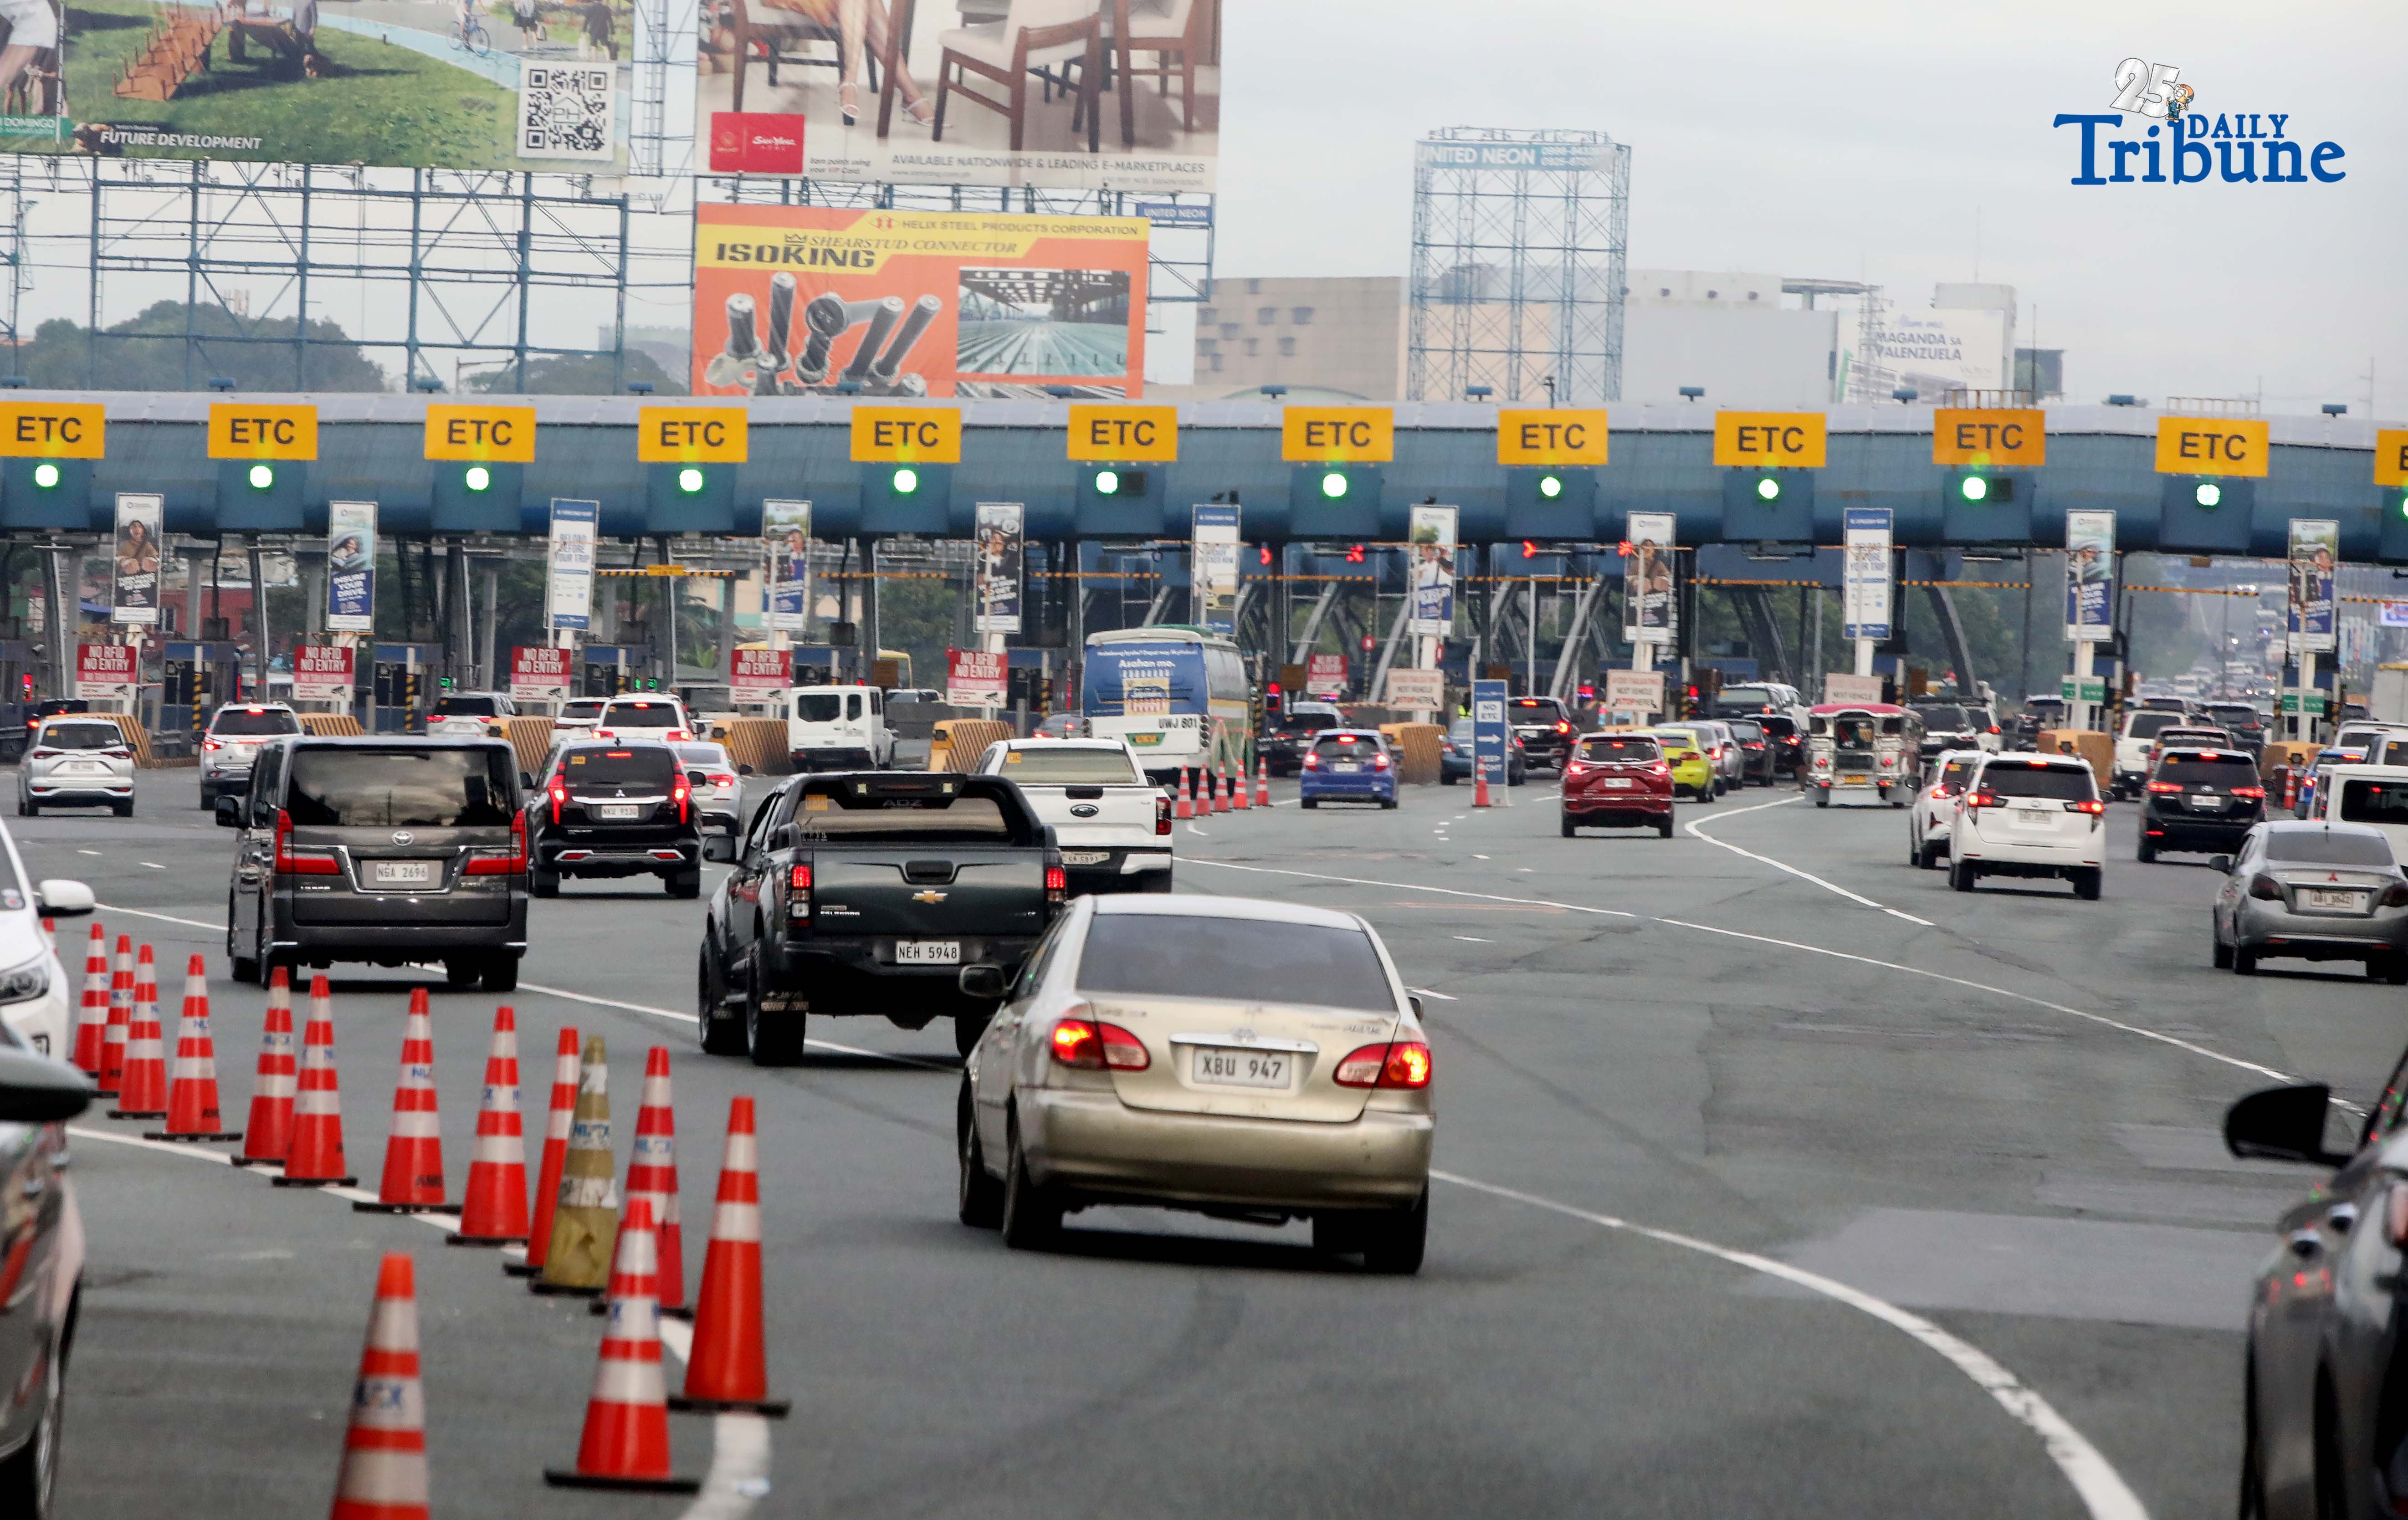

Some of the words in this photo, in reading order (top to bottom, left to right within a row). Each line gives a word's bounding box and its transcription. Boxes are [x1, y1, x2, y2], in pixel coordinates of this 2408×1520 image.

[100, 131, 156, 145] FUTURE
[157, 133, 262, 150] DEVELOPMENT
[891, 154, 954, 166] AVAILABLE
[957, 157, 1033, 169] NATIONWIDE
[1037, 159, 1044, 169] &
[1048, 159, 1098, 170] LEADING
[1102, 160, 1206, 173] E-MARKETPLACES
[1417, 144, 1477, 164] UNITED
[1482, 148, 1535, 165] NEON
[1177, 209, 1208, 219] NEON
[902, 220, 937, 230] HELIX
[940, 221, 977, 230] STEEL
[983, 222, 1049, 233] PRODUCTS
[1051, 224, 1138, 235] CORPORATION
[810, 235, 908, 250] SHEARSTUD
[913, 239, 1018, 253] CONNECTOR
[717, 242, 876, 268] ISOKING
[1877, 332, 1946, 345] MAGANDA
[17, 416, 81, 442] ETC
[231, 418, 294, 444] ETC
[448, 420, 512, 445] ETC
[661, 421, 724, 447] ETC
[875, 421, 938, 447] ETC
[1091, 420, 1155, 446] ETC
[1306, 421, 1370, 447] ETC
[1522, 424, 1585, 449] ETC
[1957, 424, 2023, 450] ETC
[1738, 426, 1803, 453] ETC
[2180, 432, 2246, 461] ETC
[89, 645, 102, 658] NO
[103, 646, 126, 659] RFID
[306, 646, 319, 659] NO
[320, 647, 342, 660] RFID
[523, 648, 537, 660] NO
[538, 649, 559, 661] RFID
[742, 650, 756, 663] NO
[757, 651, 779, 664] RFID
[960, 652, 974, 665] NO
[975, 654, 998, 666] RFID
[83, 657, 97, 670] NO
[99, 659, 130, 671] ENTRY
[300, 658, 314, 671] NO
[316, 659, 347, 672] ENTRY
[518, 660, 532, 673] NO
[533, 661, 564, 674] ENTRY
[737, 662, 751, 674] NO
[752, 663, 783, 676] ENTRY
[955, 664, 969, 677] NO
[970, 665, 1001, 678] ENTRY
[898, 946, 920, 959] NEH
[928, 946, 958, 960] 5948
[1202, 1056, 1236, 1077] XBU
[1249, 1059, 1283, 1080] 947
